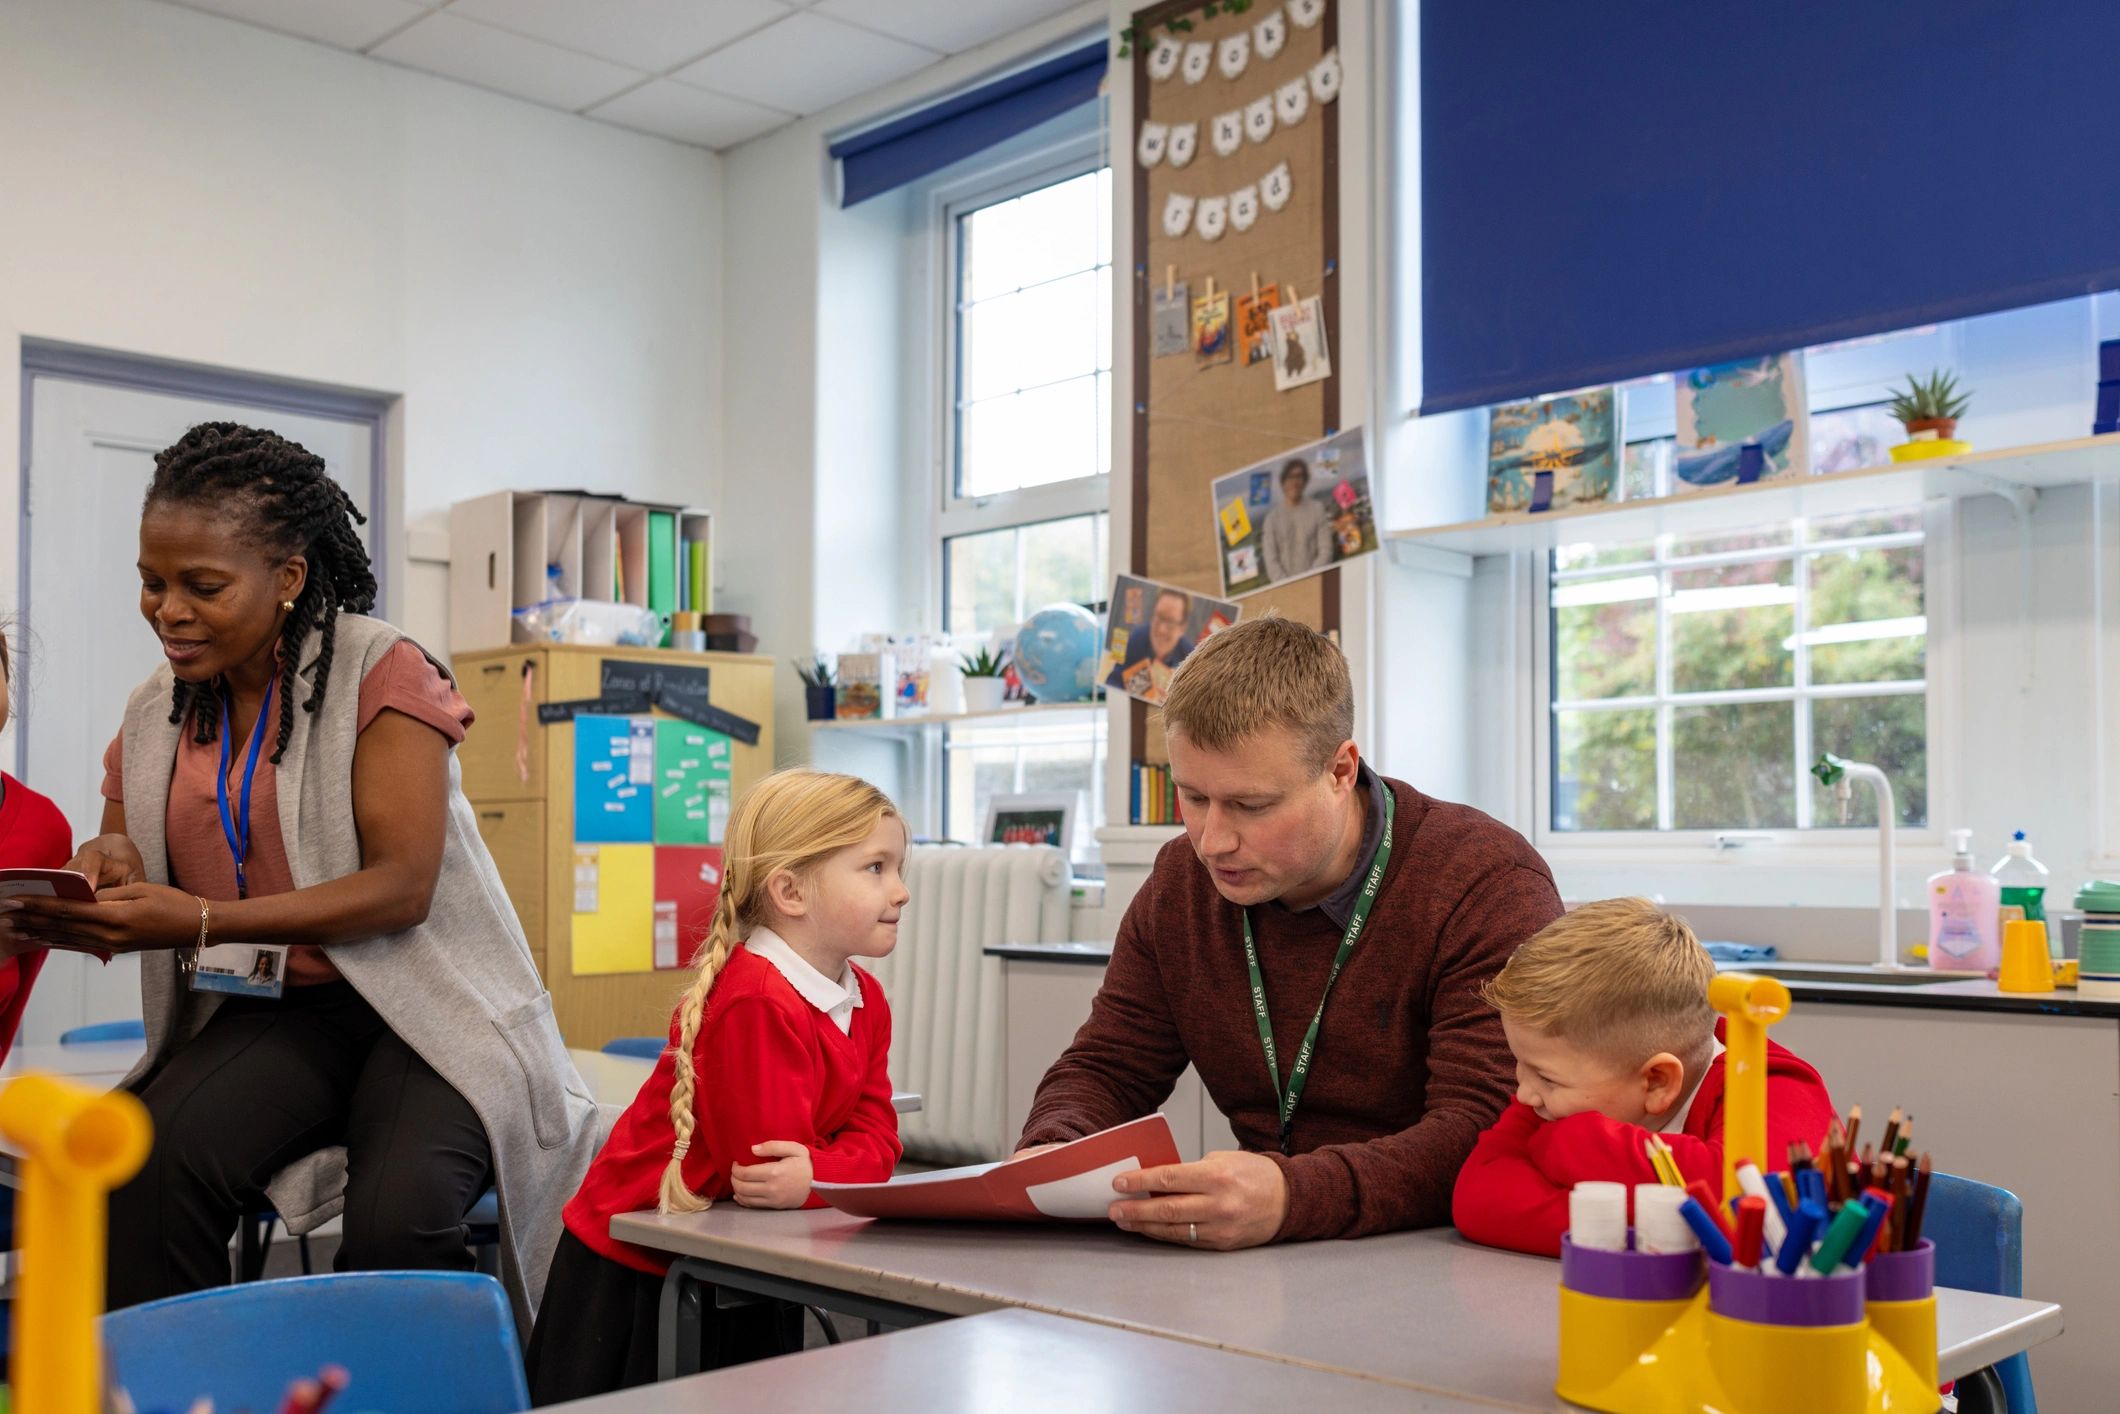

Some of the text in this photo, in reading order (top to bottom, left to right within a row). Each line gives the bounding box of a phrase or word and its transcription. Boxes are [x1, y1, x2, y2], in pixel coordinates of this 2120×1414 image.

[1221, 71, 1333, 141] have
[1171, 176, 1283, 226] read
[1383, 819, 1393, 848] STAFF
[1365, 864, 1382, 897] STAFF
[1345, 913, 1363, 946] STAFF
[1245, 935, 1256, 968] STAFF
[1253, 986, 1266, 1019] STAFF
[1263, 1036, 1276, 1069] STAFF
[1296, 1040, 1311, 1074] STAFF
[1285, 1090, 1297, 1122] STAFF
